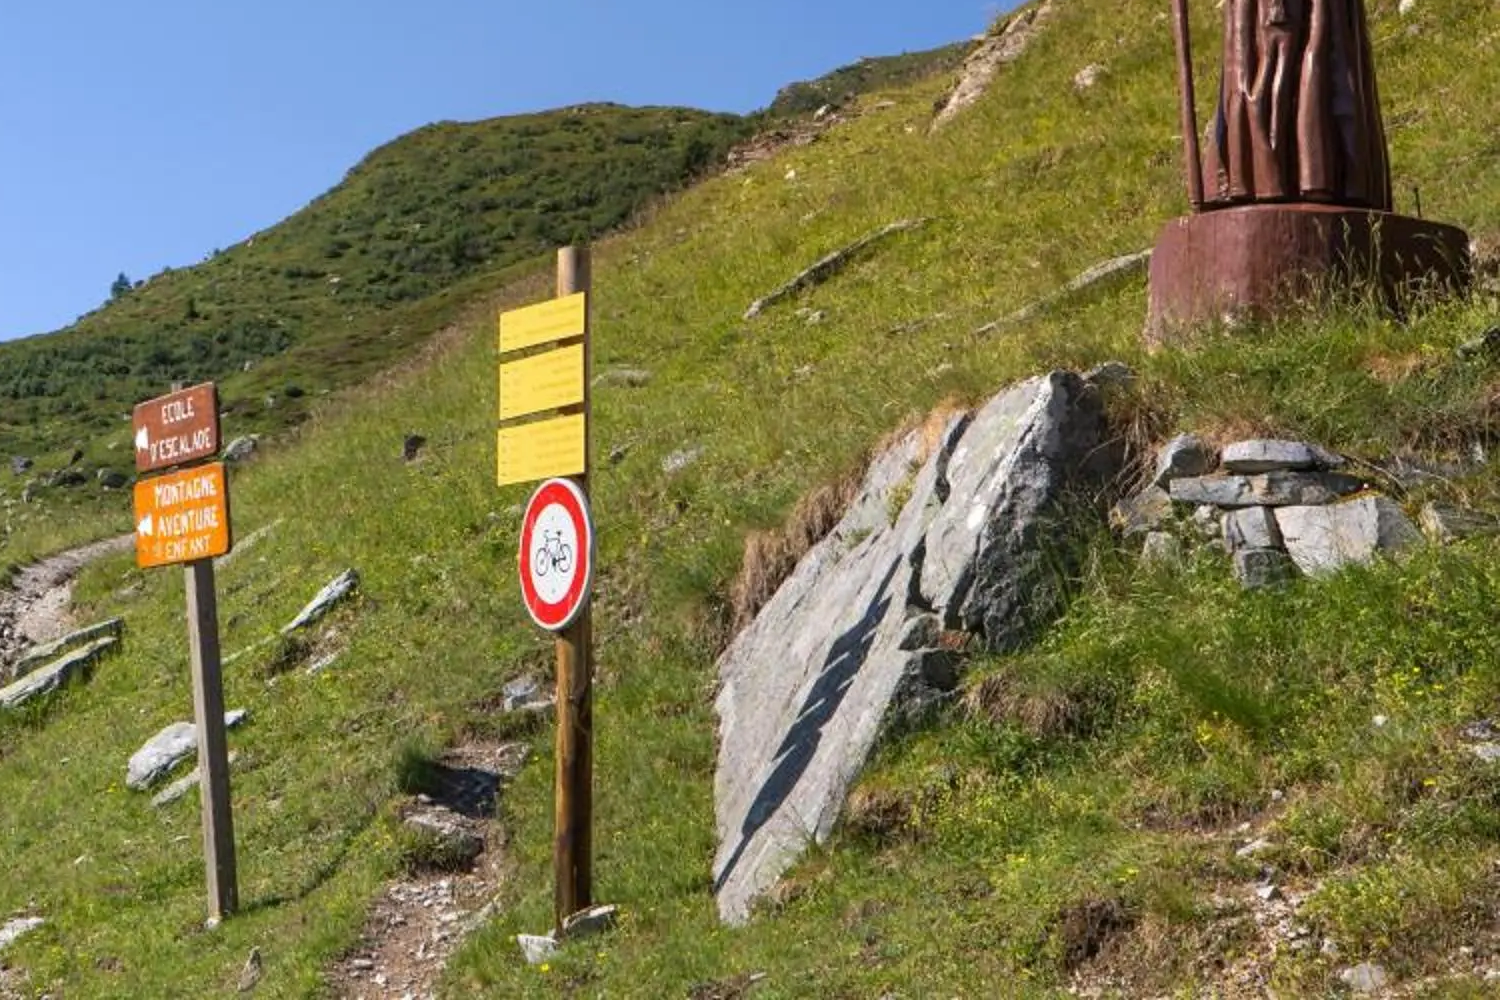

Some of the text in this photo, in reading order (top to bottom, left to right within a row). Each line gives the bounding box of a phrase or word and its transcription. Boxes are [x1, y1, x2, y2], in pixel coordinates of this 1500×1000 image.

[161, 396, 195, 425] ECOLE
[154, 473, 217, 509] MONTAGNE
[157, 505, 219, 537] AVENTURE
[165, 535, 211, 560] ENFANT
